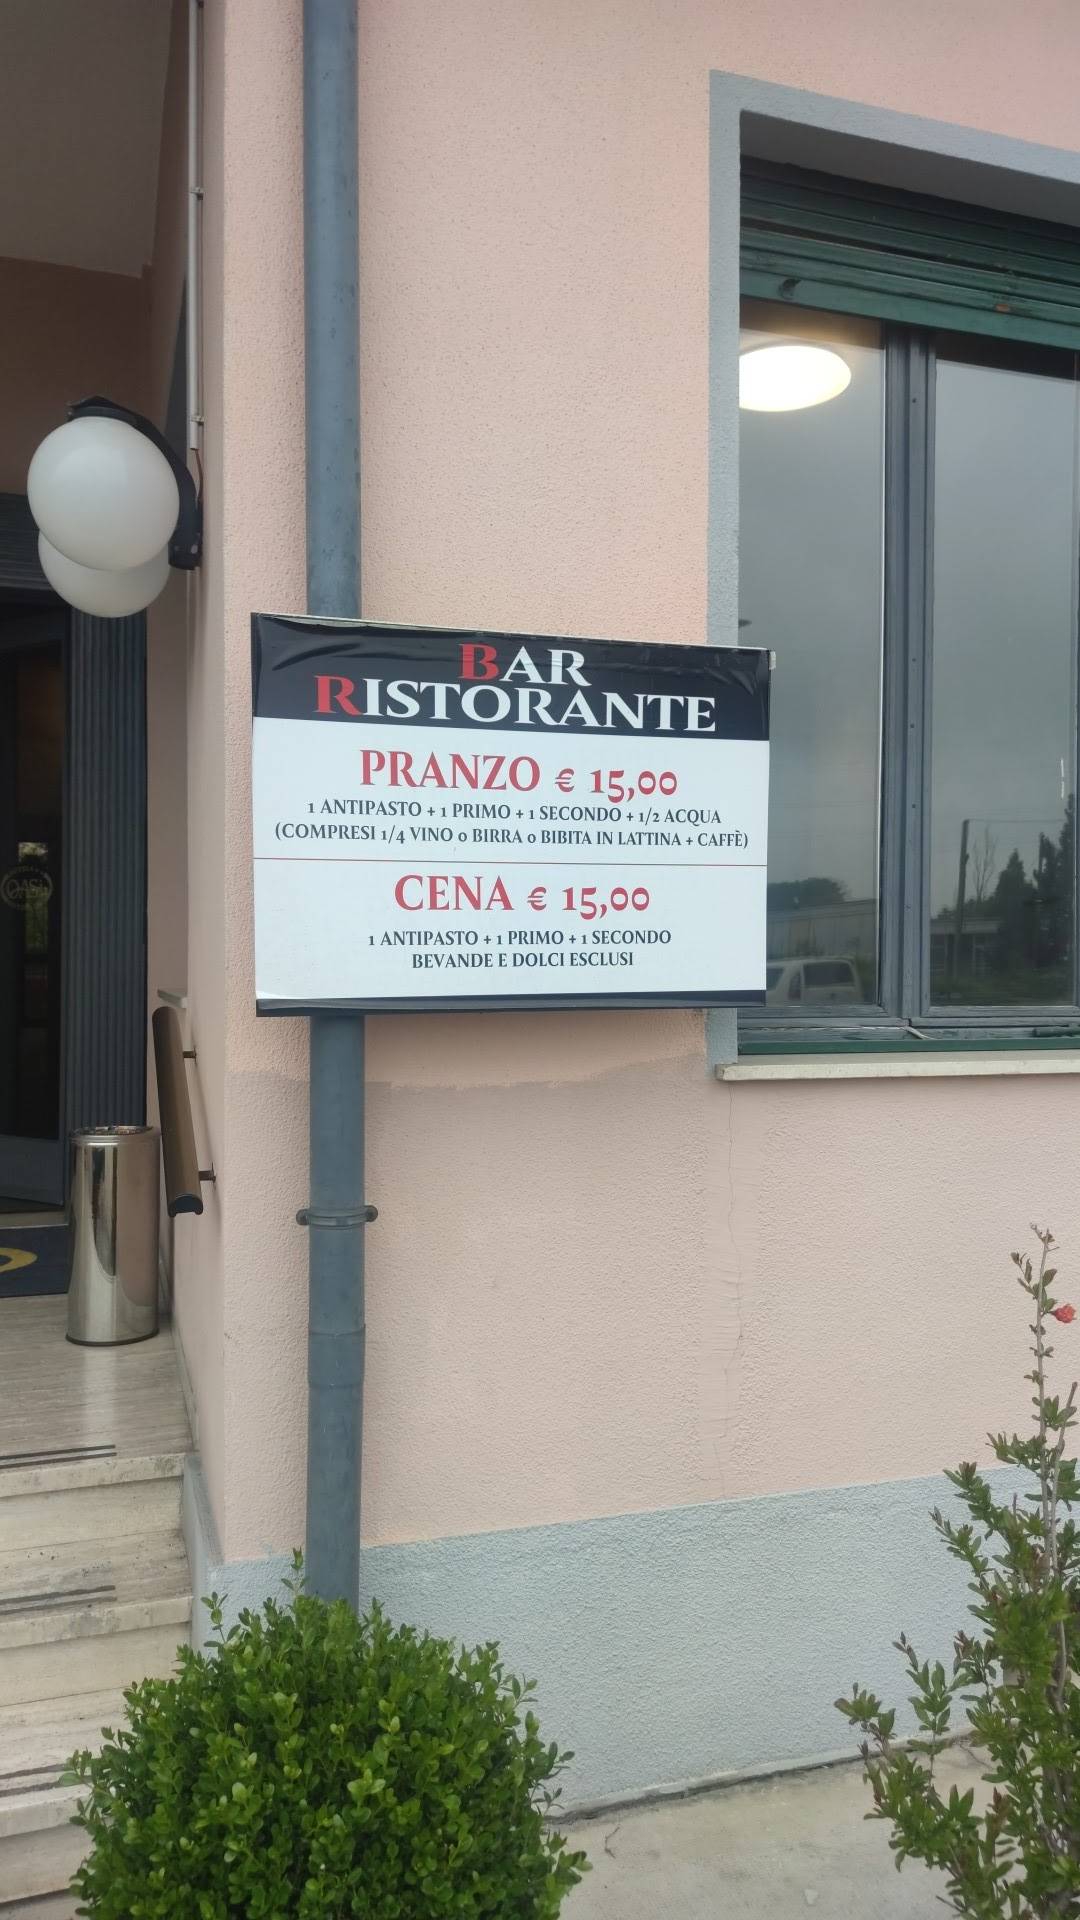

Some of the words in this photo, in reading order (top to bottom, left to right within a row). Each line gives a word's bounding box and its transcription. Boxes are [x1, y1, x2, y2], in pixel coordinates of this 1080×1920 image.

[458, 641, 592, 687] BAR
[313, 675, 716, 732] RISTORANTE
[360, 749, 540, 792] PRANZO
[554, 768, 575, 793] €
[590, 769, 677, 803] 15,00
[320, 799, 422, 817] ANTIPASTO
[453, 804, 511, 819] PRIMO
[539, 806, 622, 822] SECONDO
[639, 807, 660, 826] 1/2
[664, 809, 722, 827] ACQUA
[275, 822, 375, 840] (COMPRESI
[381, 825, 405, 845] 1/4
[409, 827, 454, 842] VINO
[473, 828, 522, 844] BIRRA
[540, 830, 592, 845] BIBITA
[596, 831, 614, 845] IN
[618, 831, 682, 846] LATTINA
[697, 830, 748, 849] CAFFÈ)
[394, 874, 515, 911] CENA
[527, 886, 547, 911] €
[562, 886, 650, 921] 15,00
[380, 930, 479, 947] ANTIPASTO
[508, 930, 564, 946] PRIMO
[592, 929, 672, 945] SECONDO
[412, 953, 493, 969] BEVANDE
[498, 953, 508, 968] E
[512, 952, 565, 968] DOLCI
[569, 951, 634, 967] ESCLUSI
